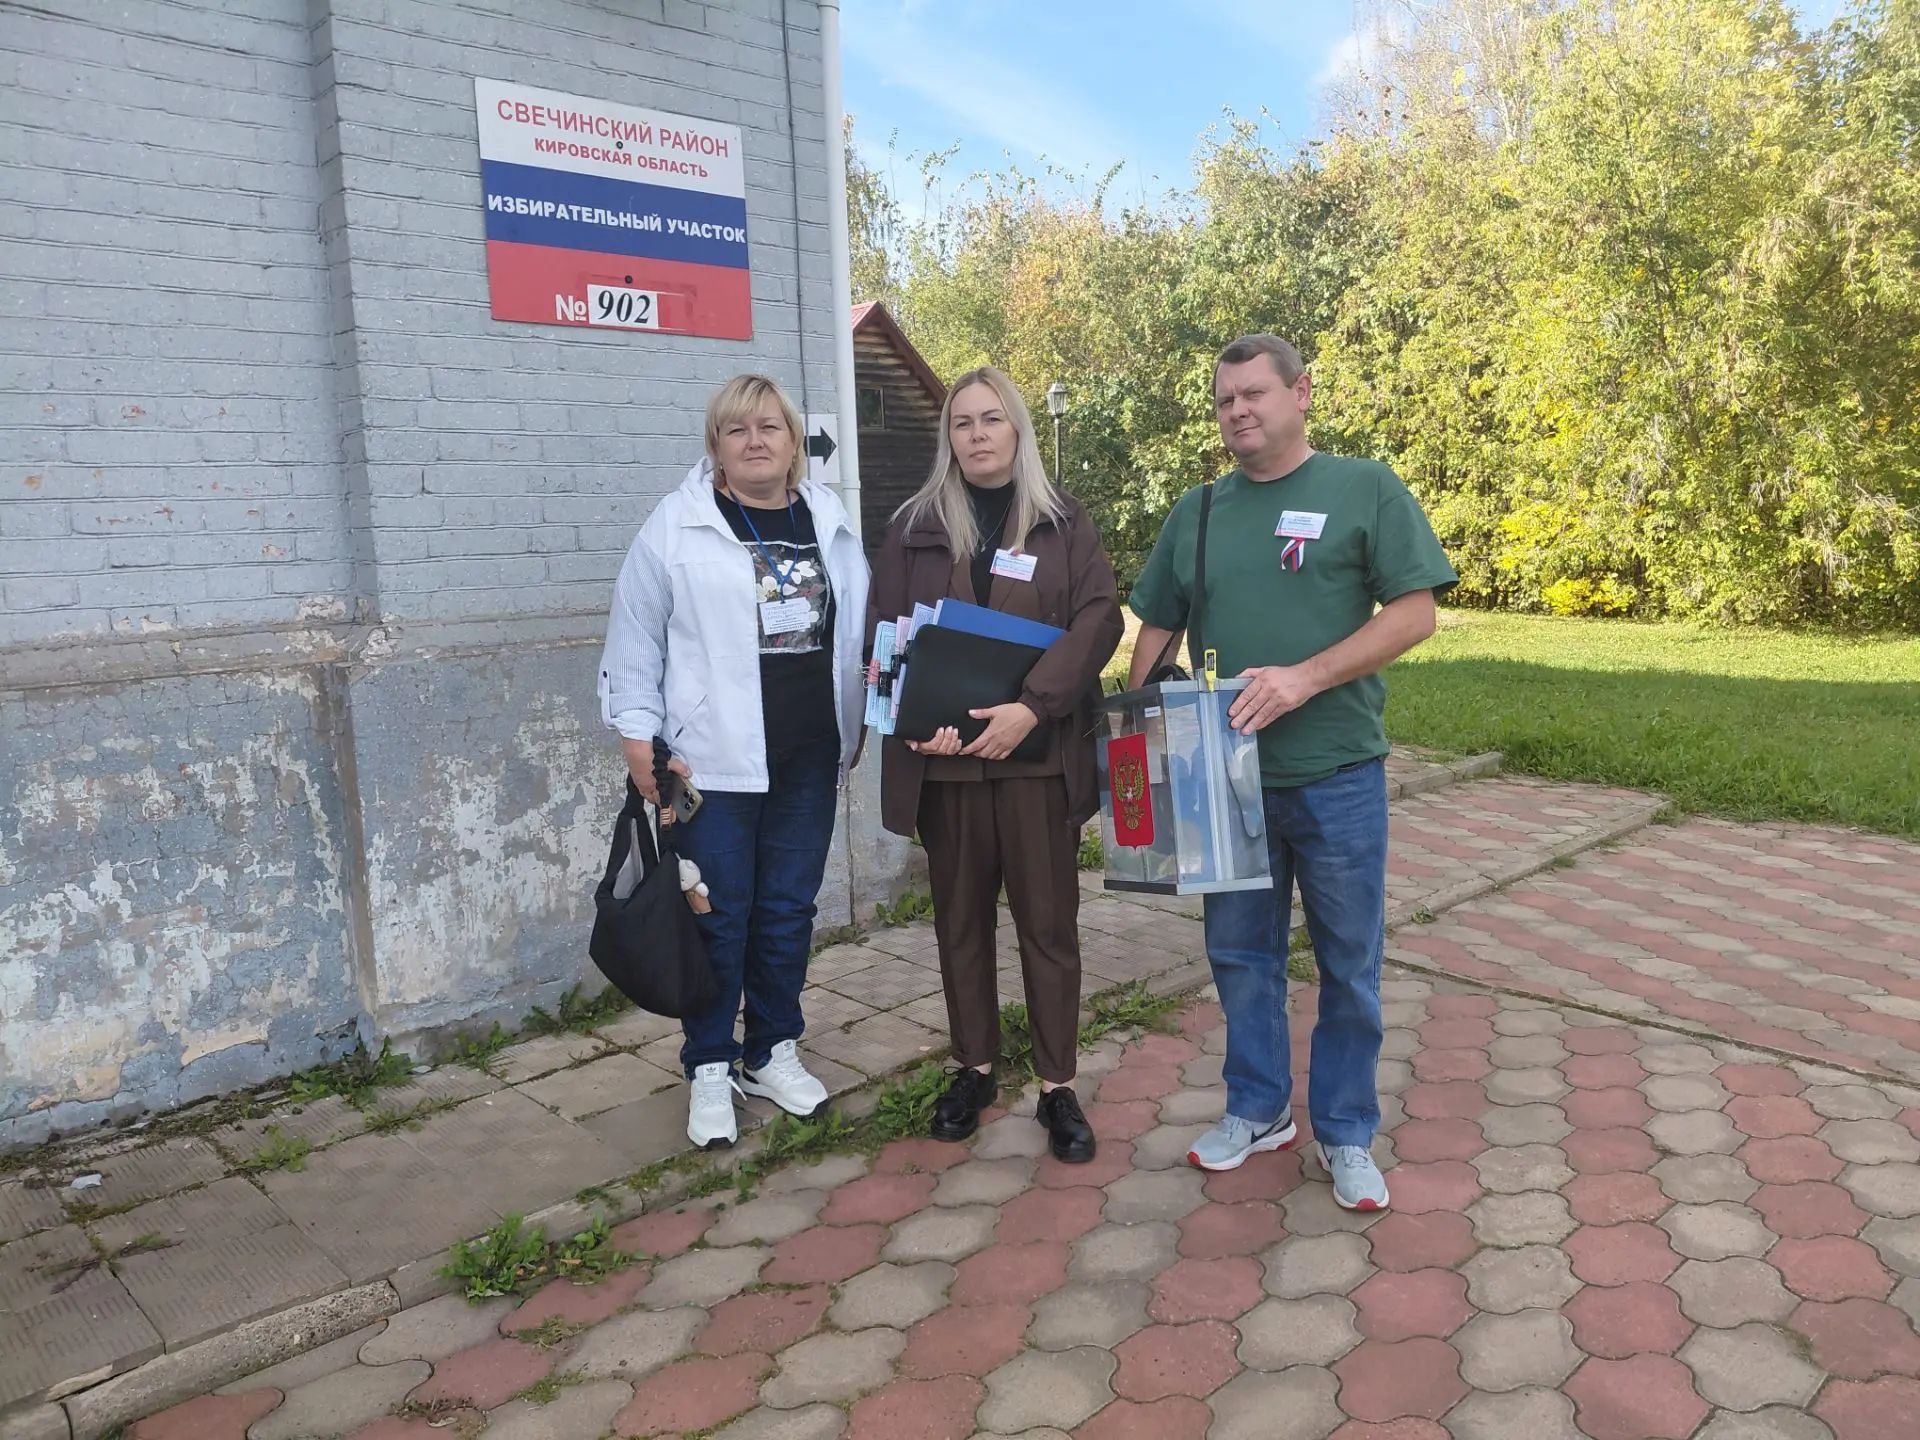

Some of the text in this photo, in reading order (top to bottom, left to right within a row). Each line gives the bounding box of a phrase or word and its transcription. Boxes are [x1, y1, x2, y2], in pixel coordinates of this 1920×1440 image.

[497, 99, 729, 158] СВЕЧИНСКИЙ РАЙОН
[534, 137, 709, 178] КИРОВСКАЯ ОБЛАСТЬ
[487, 193, 746, 244] ИЗБИРАТЕЛЬНЫЙ УЧАСТОК
[555, 290, 651, 325] № 902
